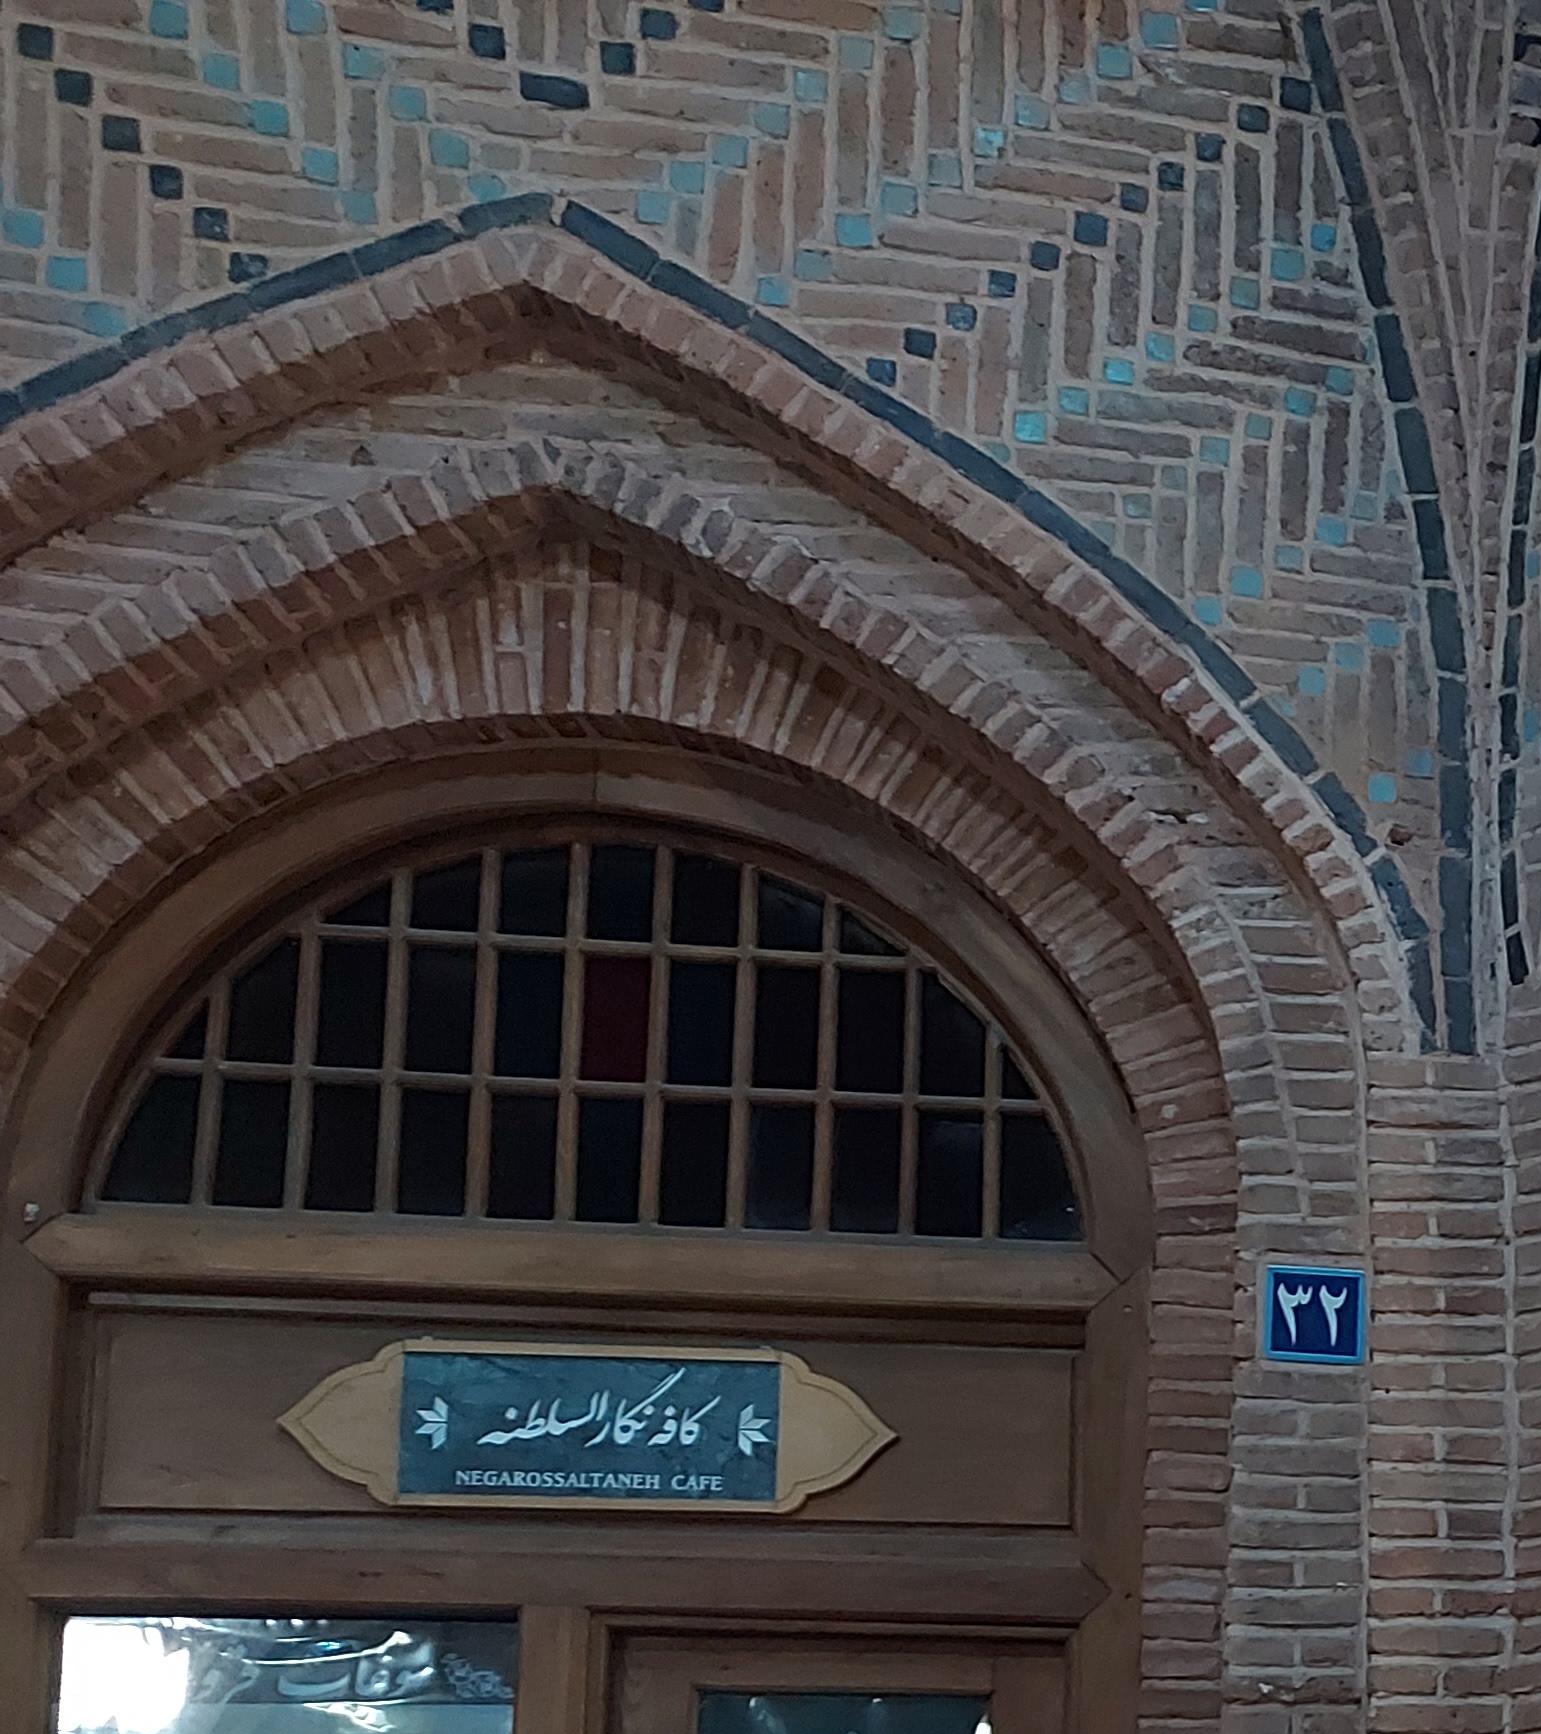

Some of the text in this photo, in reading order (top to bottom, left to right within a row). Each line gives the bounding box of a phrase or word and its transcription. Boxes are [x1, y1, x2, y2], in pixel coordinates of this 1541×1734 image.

[1276, 1282, 1348, 1347] ۳۲
[646, 1395, 721, 1448] کافه
[454, 1468, 723, 1492] NEGAROSSALTANEH CAFE
